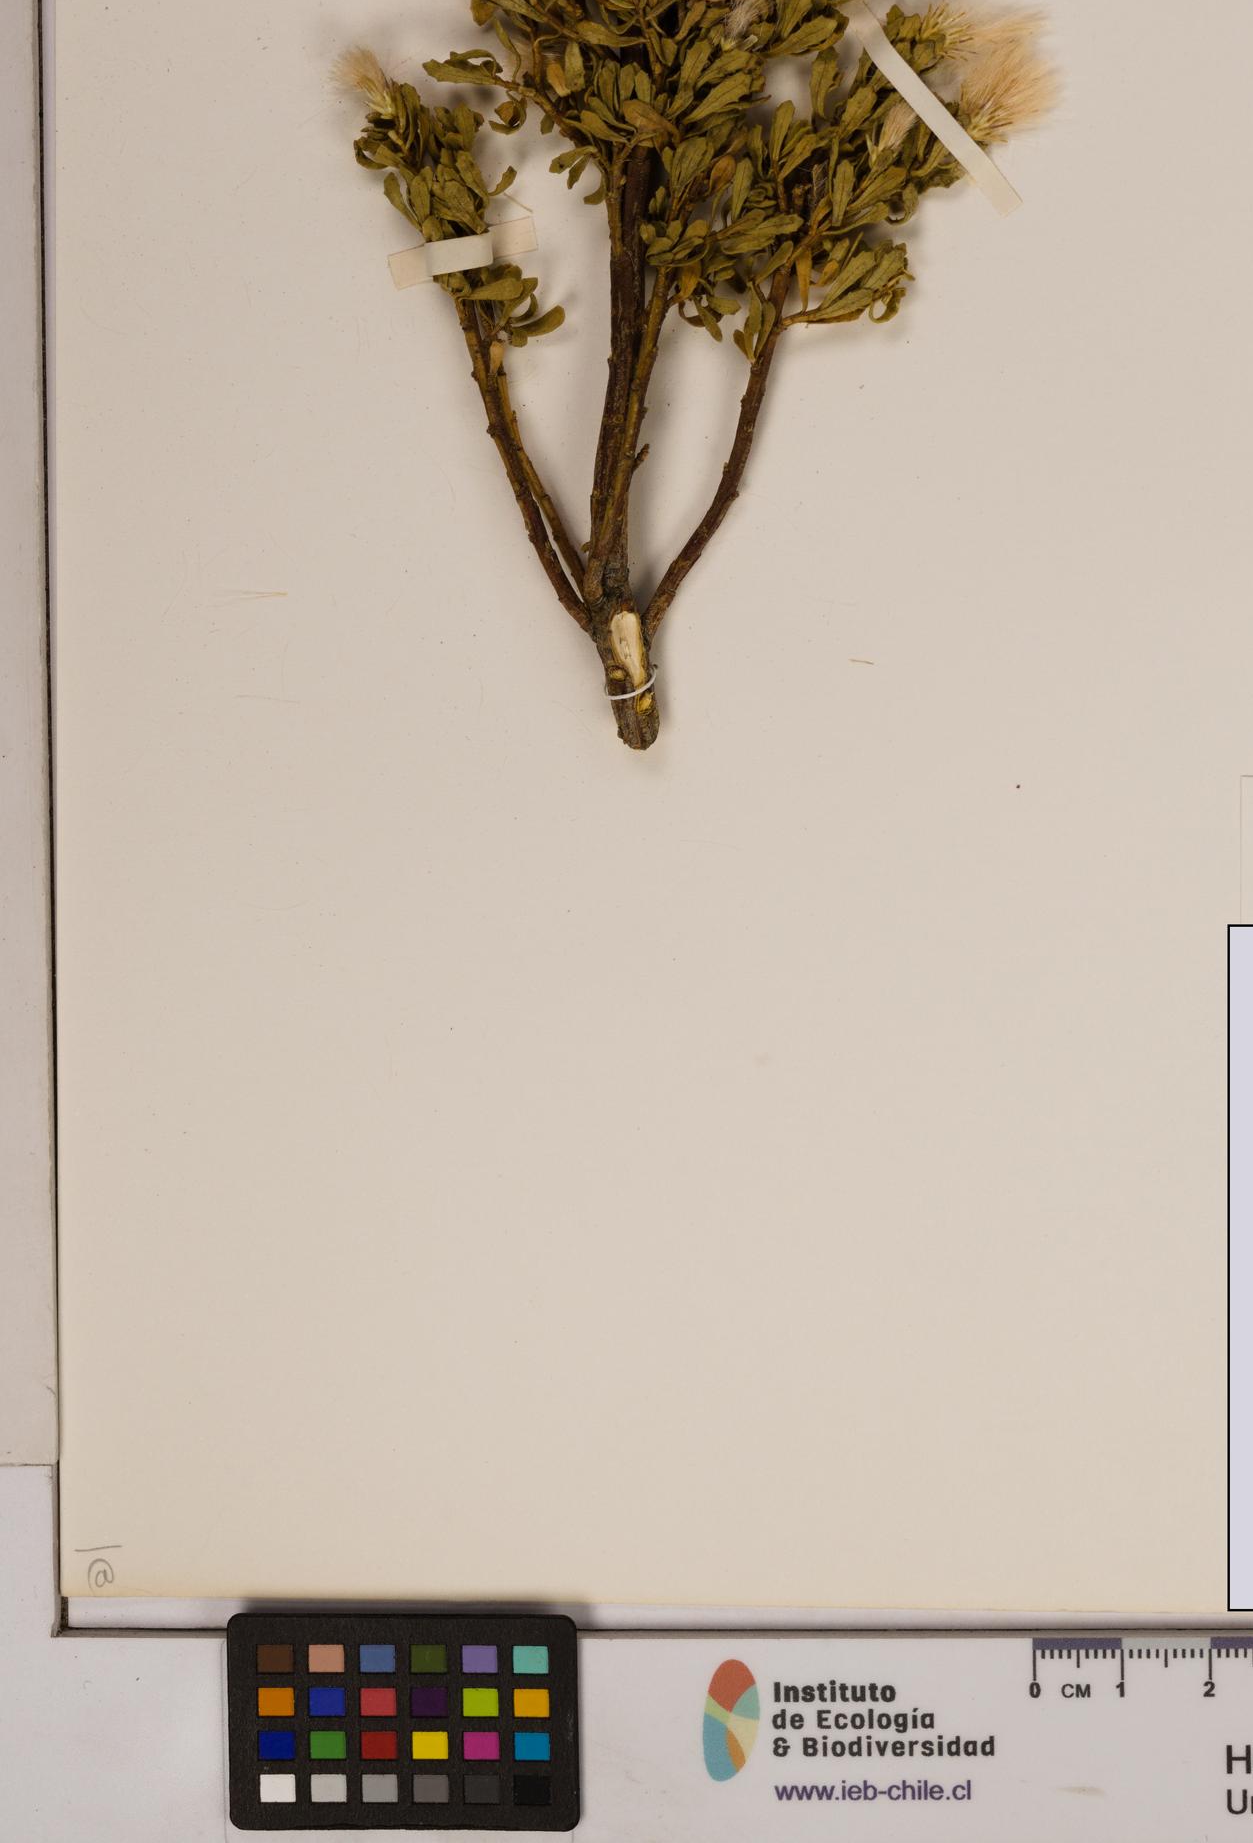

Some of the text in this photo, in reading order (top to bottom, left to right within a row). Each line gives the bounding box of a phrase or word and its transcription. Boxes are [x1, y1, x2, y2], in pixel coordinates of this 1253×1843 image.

[773, 1679, 897, 1703] Instituto
[1028, 1679, 1042, 1699] 0
[1060, 1683, 1092, 1699] CM
[1115, 1678, 1126, 1698] 1
[1202, 1678, 1216, 1698] 2
[771, 1707, 935, 1738] de Ecología
[772, 1734, 995, 1758] & Biodiversidad
[773, 1779, 972, 1802] www.ieb-chile.cl
